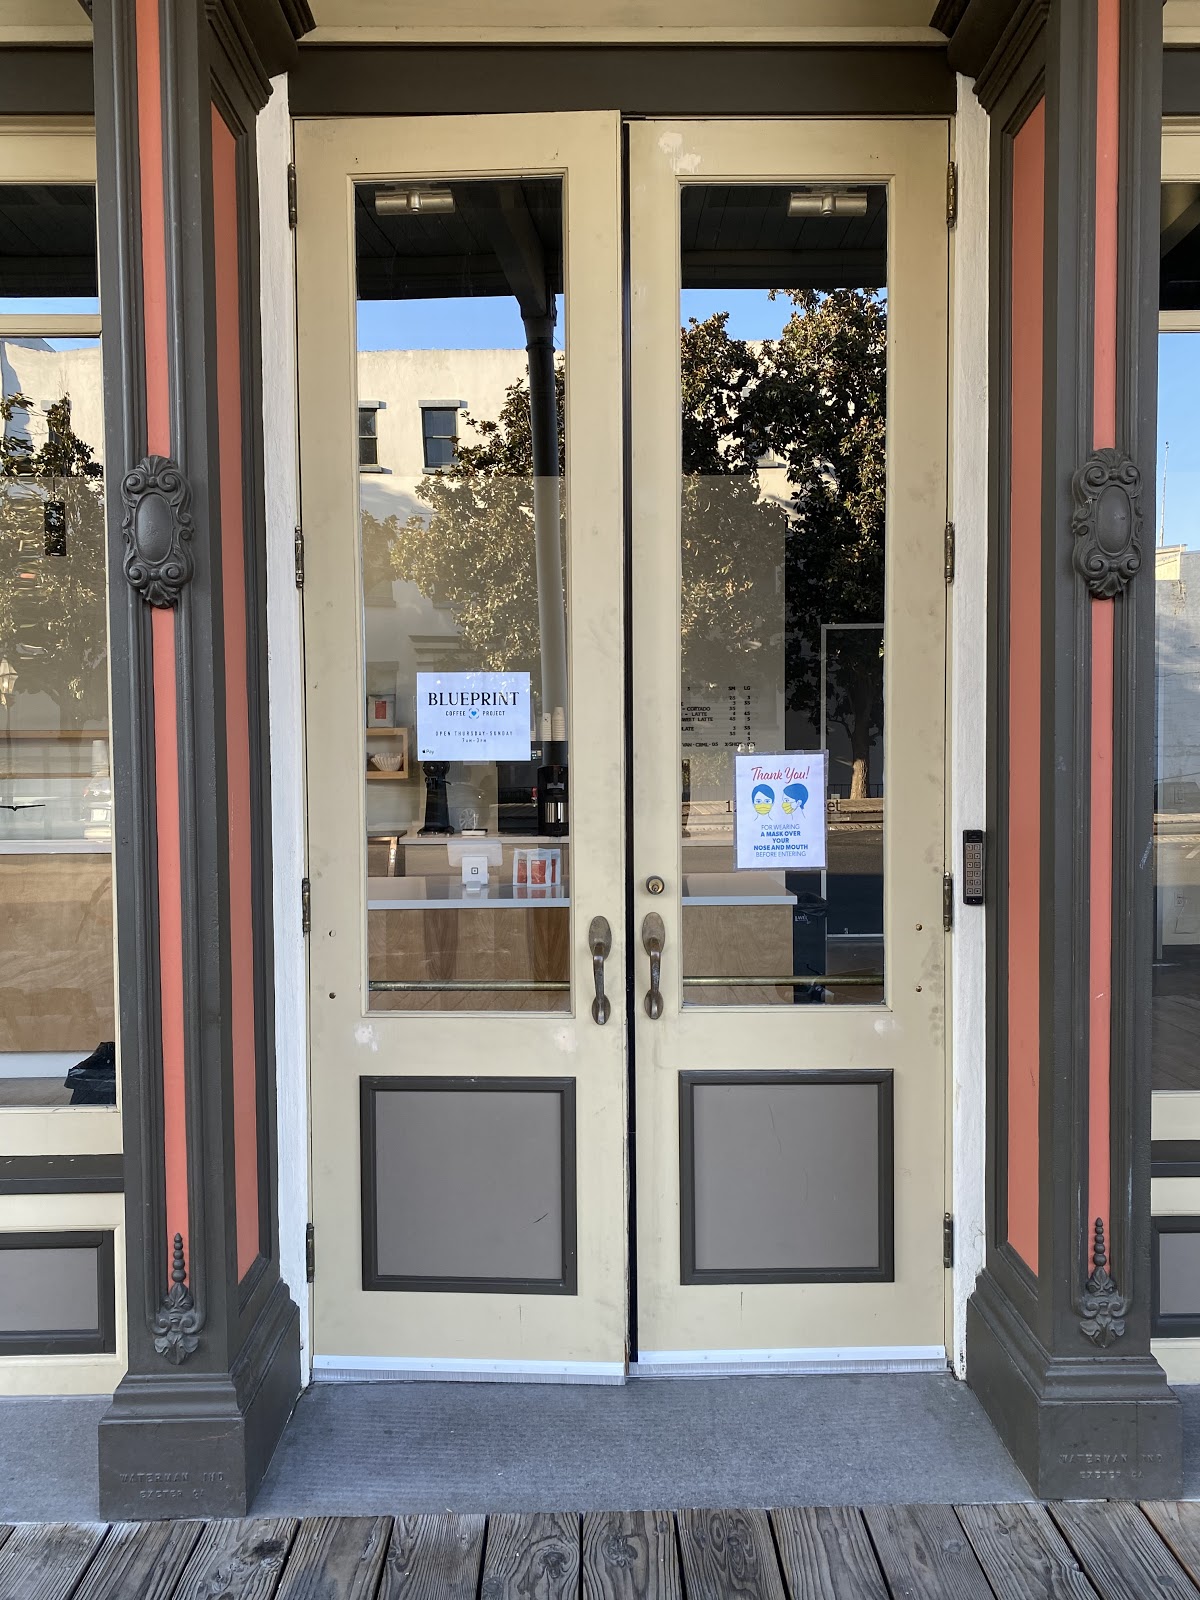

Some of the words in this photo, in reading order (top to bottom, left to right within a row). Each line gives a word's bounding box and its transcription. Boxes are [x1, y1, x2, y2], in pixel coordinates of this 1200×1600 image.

[428, 692, 520, 706] BLUEPRINT
[751, 766, 783, 782] Thank
[784, 766, 810, 784] You!
[120, 1472, 189, 1482] WATERMAN
